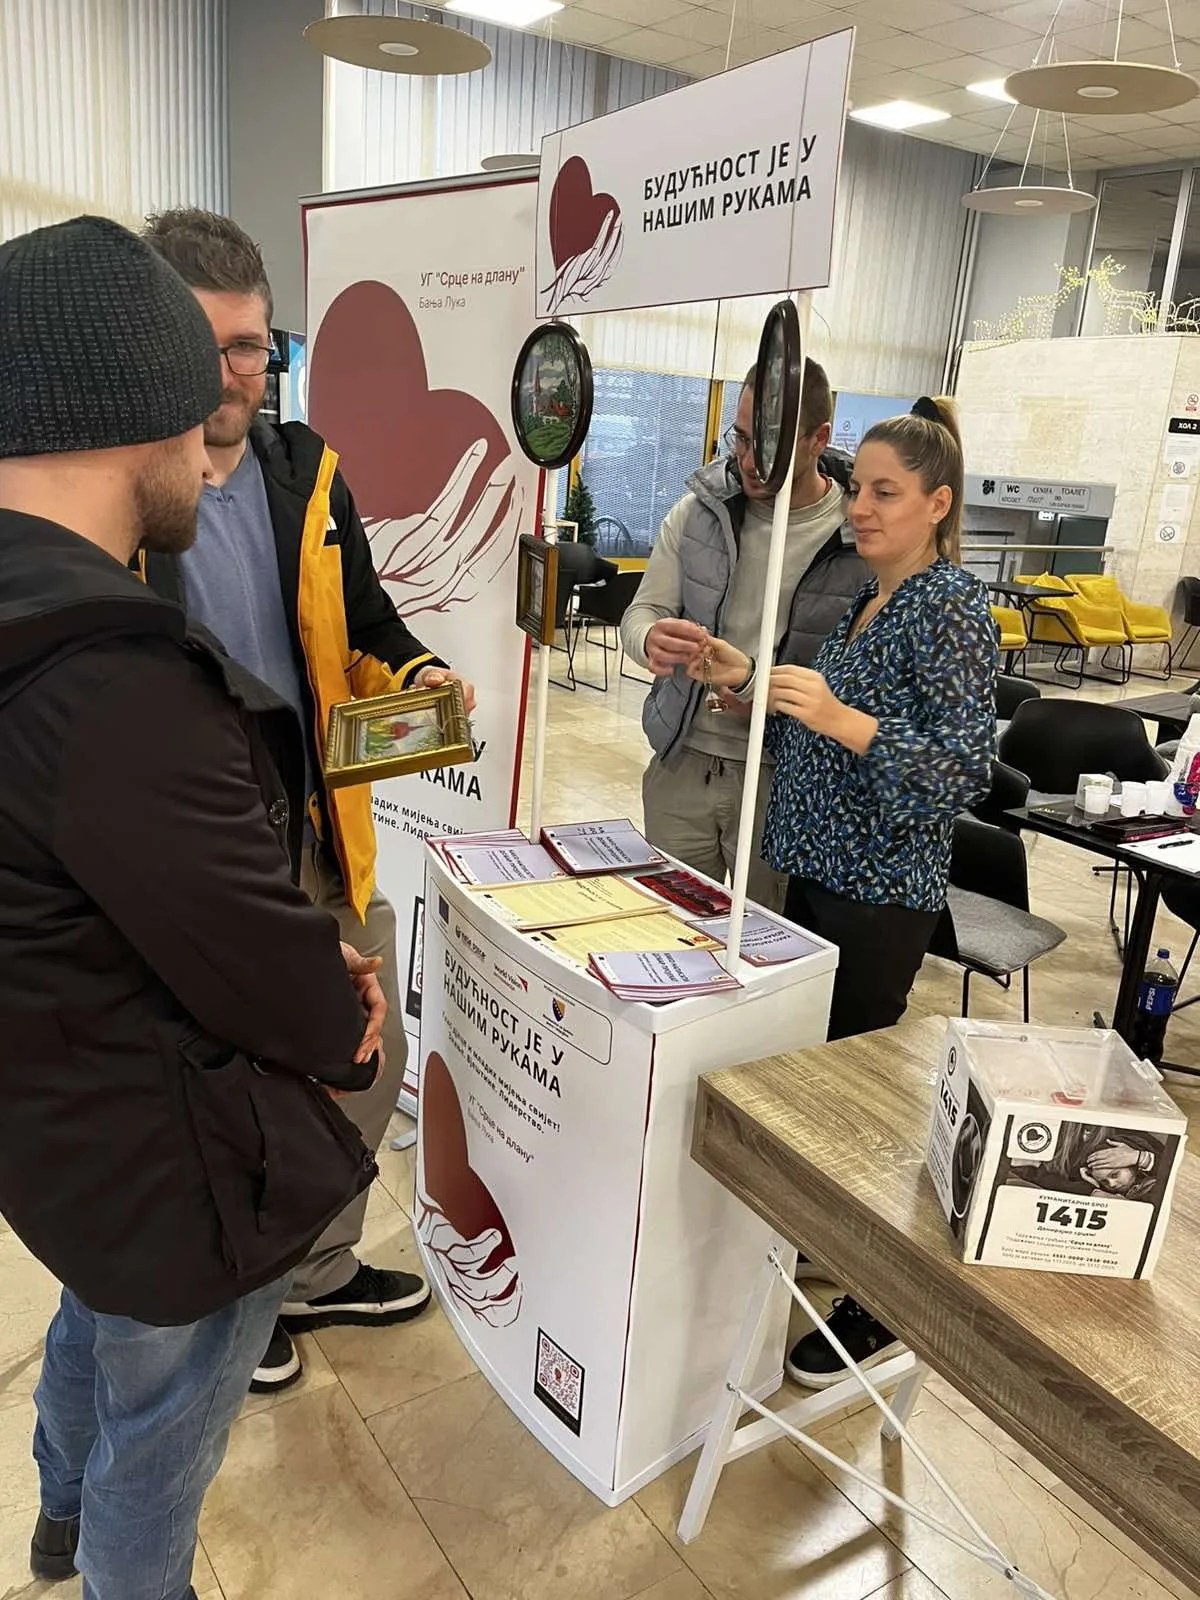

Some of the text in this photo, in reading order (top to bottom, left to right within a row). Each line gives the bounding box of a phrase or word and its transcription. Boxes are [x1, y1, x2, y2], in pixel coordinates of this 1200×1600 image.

[644, 135, 817, 201] БУДУЋНОСТ ЈЕ У
[643, 175, 812, 232] НАШИМ РУКАМА
[420, 266, 525, 288] УГ "Срце на длану"
[419, 295, 466, 310] Бања Лука
[1006, 484, 1020, 494] WC
[371, 795, 399, 813] адих
[402, 807, 439, 829] мијења
[444, 950, 519, 1034] БУДУЋНОСТ
[525, 1027, 542, 1054] ЈЕ
[551, 1045, 564, 1066] У
[1145, 987, 1156, 1011] PEPSI
[444, 973, 561, 1098] НАШИМ РУКАМА
[498, 1075, 527, 1107] мијења
[529, 1103, 561, 1132] свијет!
[499, 1090, 545, 1134] Лидерство.
[941, 1079, 958, 1127] 1415
[1036, 1201, 1108, 1230] 1415
